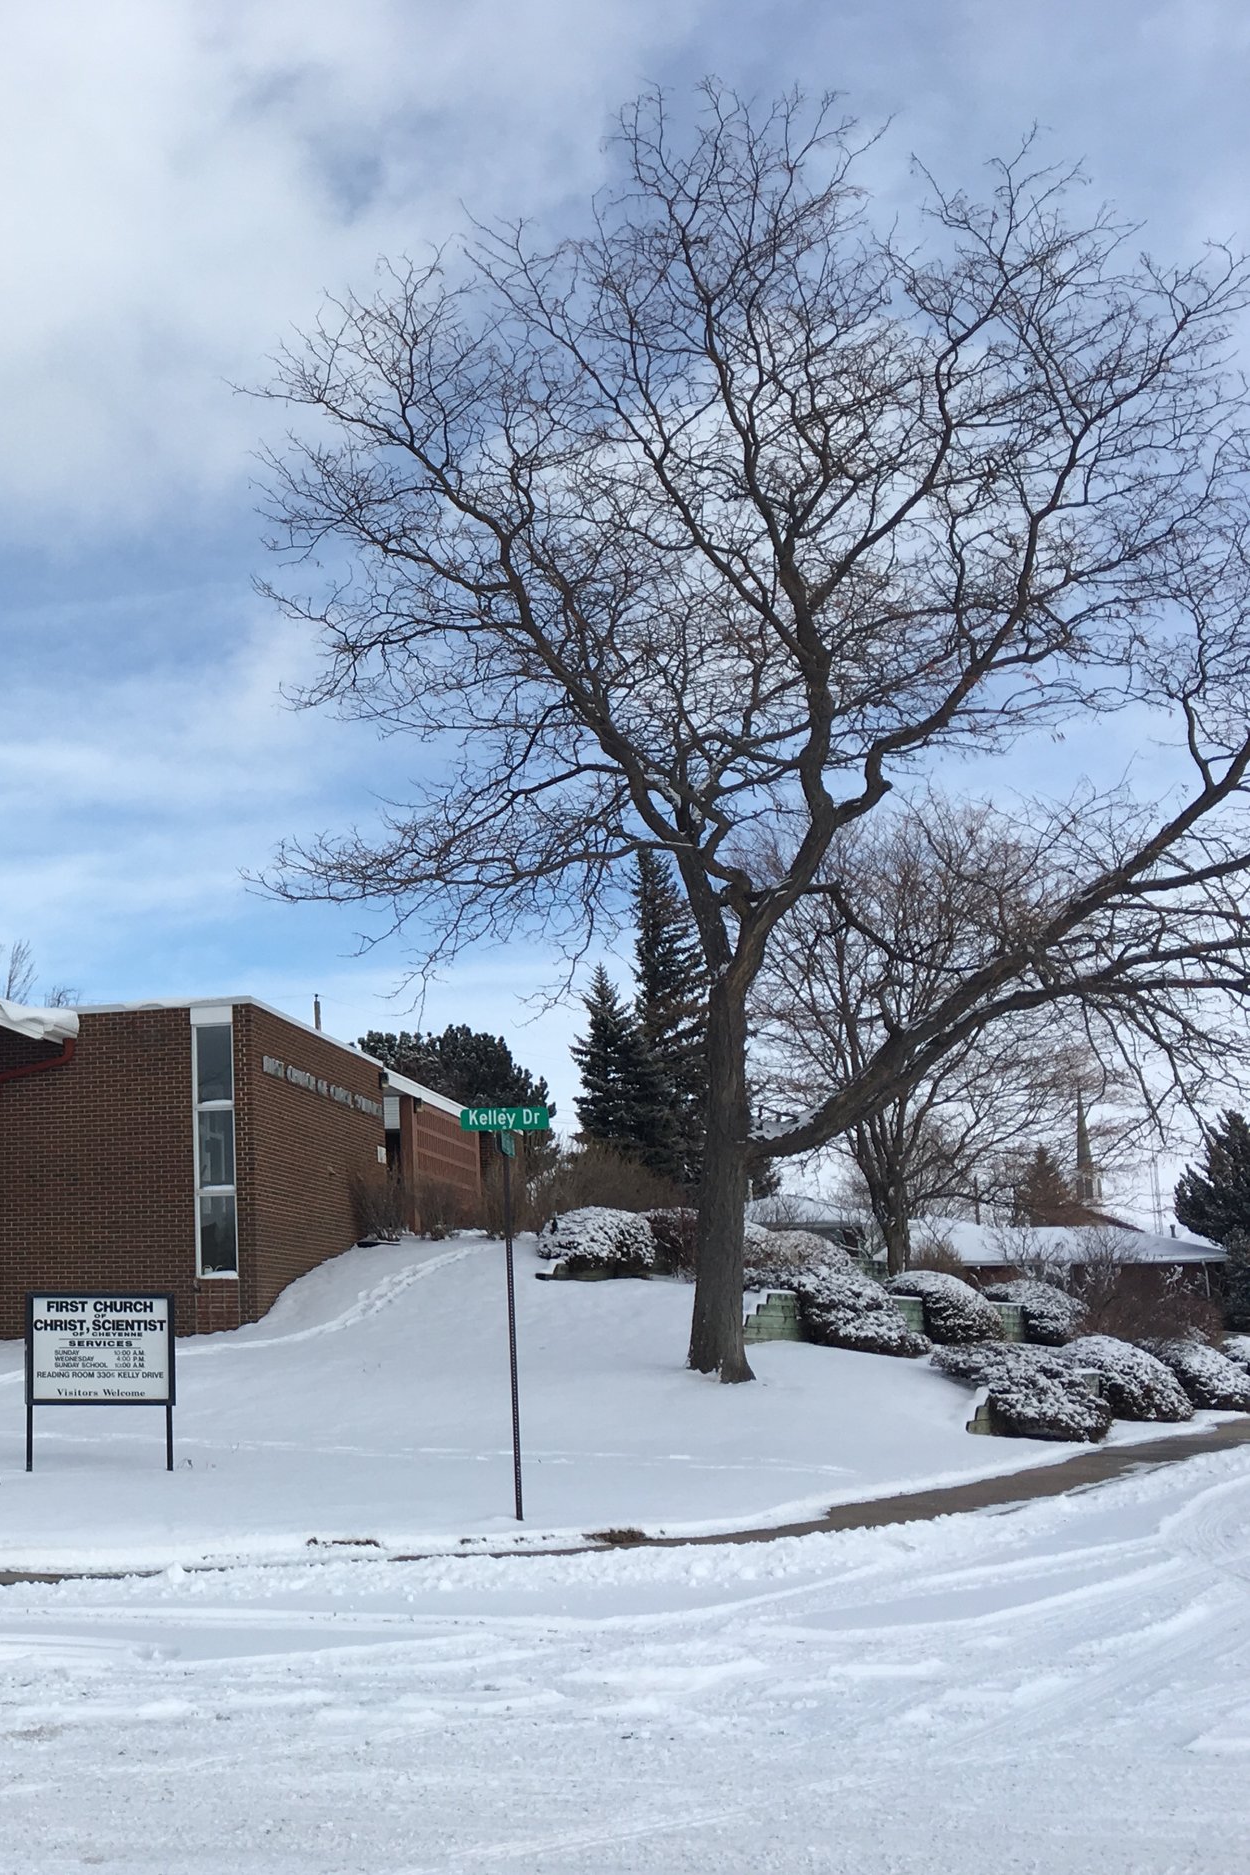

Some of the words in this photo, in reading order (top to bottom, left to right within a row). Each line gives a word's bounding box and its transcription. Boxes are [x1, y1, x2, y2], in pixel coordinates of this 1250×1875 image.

[469, 1110, 516, 1129] Kelley
[523, 1109, 540, 1124] Dr
[47, 1301, 88, 1312] FIRST
[93, 1301, 153, 1312] CHURCH
[33, 1319, 90, 1333] CHRIST,
[92, 1319, 166, 1331] SCIENTIST
[141, 1371, 164, 1379] DRIVE
[57, 1389, 98, 1397] Visitors
[103, 1389, 146, 1397] Welcome
